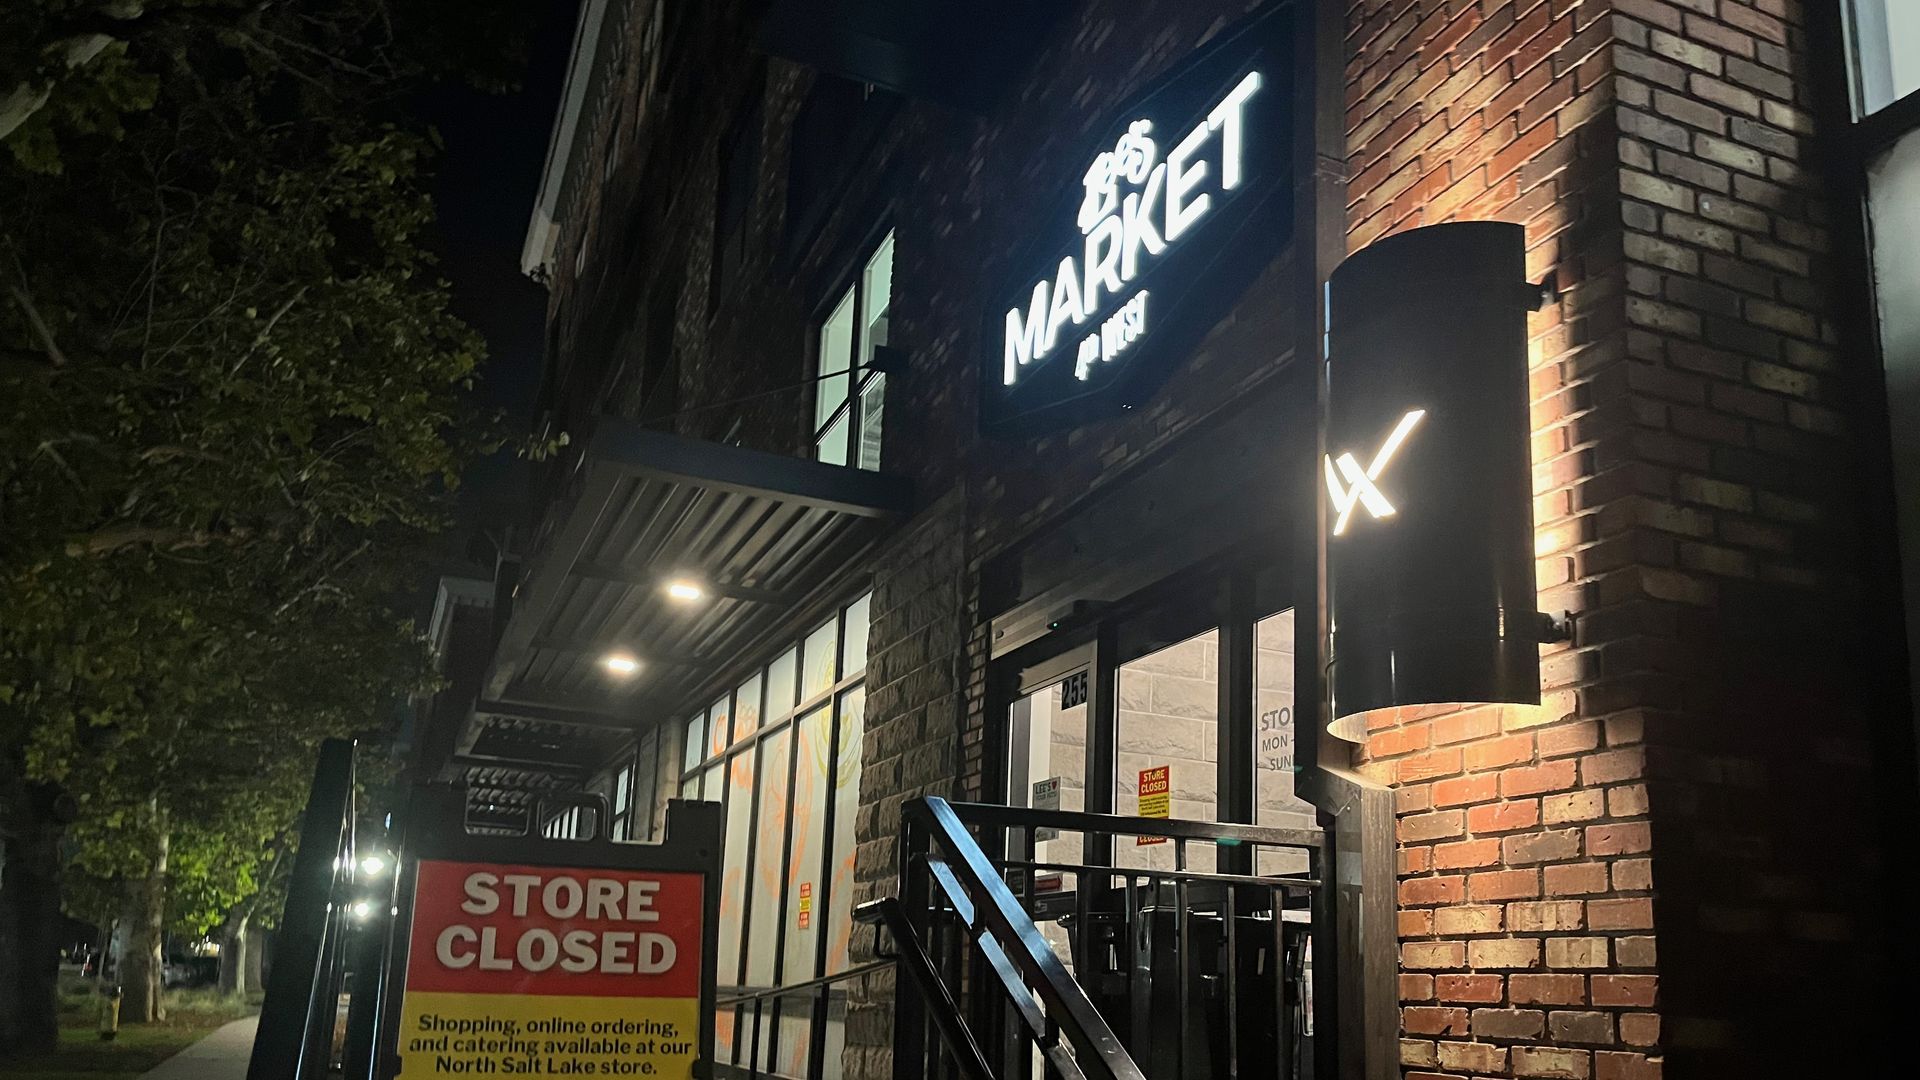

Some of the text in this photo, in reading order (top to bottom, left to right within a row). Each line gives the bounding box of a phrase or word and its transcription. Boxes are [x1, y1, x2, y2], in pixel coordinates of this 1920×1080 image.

[1003, 70, 1261, 386] MARKET
[1061, 671, 1088, 709] 255
[1261, 704, 1294, 732] STO
[1262, 733, 1288, 752] MON
[1270, 753, 1294, 771] SUN
[1140, 780, 1167, 794] CLOSED
[1143, 769, 1165, 783] STORE
[461, 872, 661, 922] STORE
[436, 925, 677, 974] CLOSED
[418, 1014, 679, 1038] Shopping, online ordering,
[409, 1035, 692, 1057] and catering available at our
[436, 1055, 657, 1075] North Salt Lake store.
